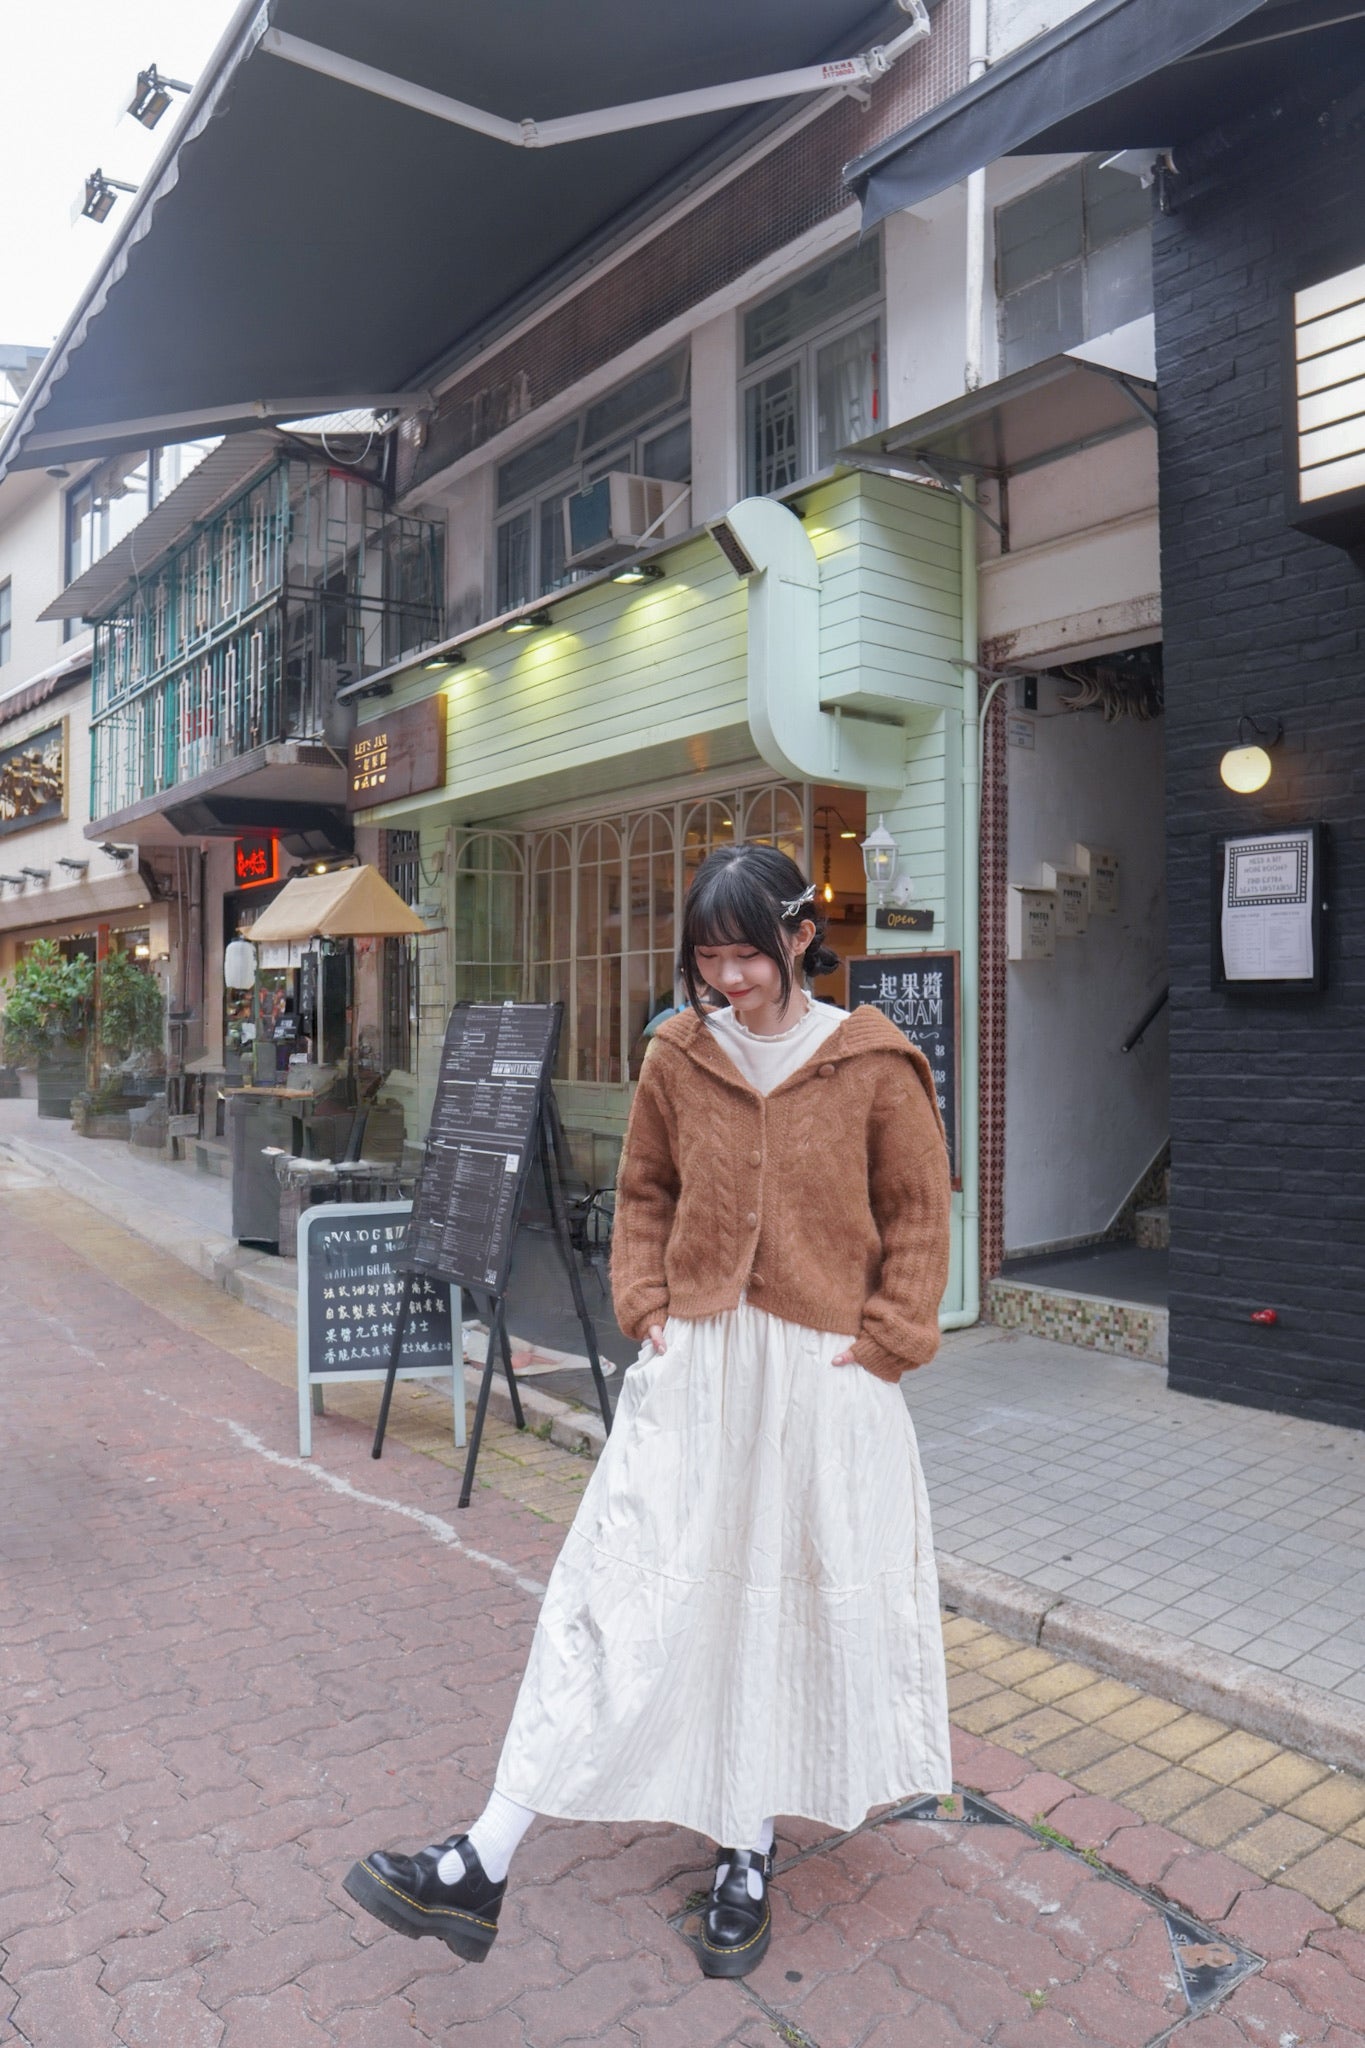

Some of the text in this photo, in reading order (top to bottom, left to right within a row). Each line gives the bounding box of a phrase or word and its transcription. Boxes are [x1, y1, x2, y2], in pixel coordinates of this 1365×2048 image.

[887, 912, 918, 927] Open
[859, 971, 943, 999] 一起果醬
